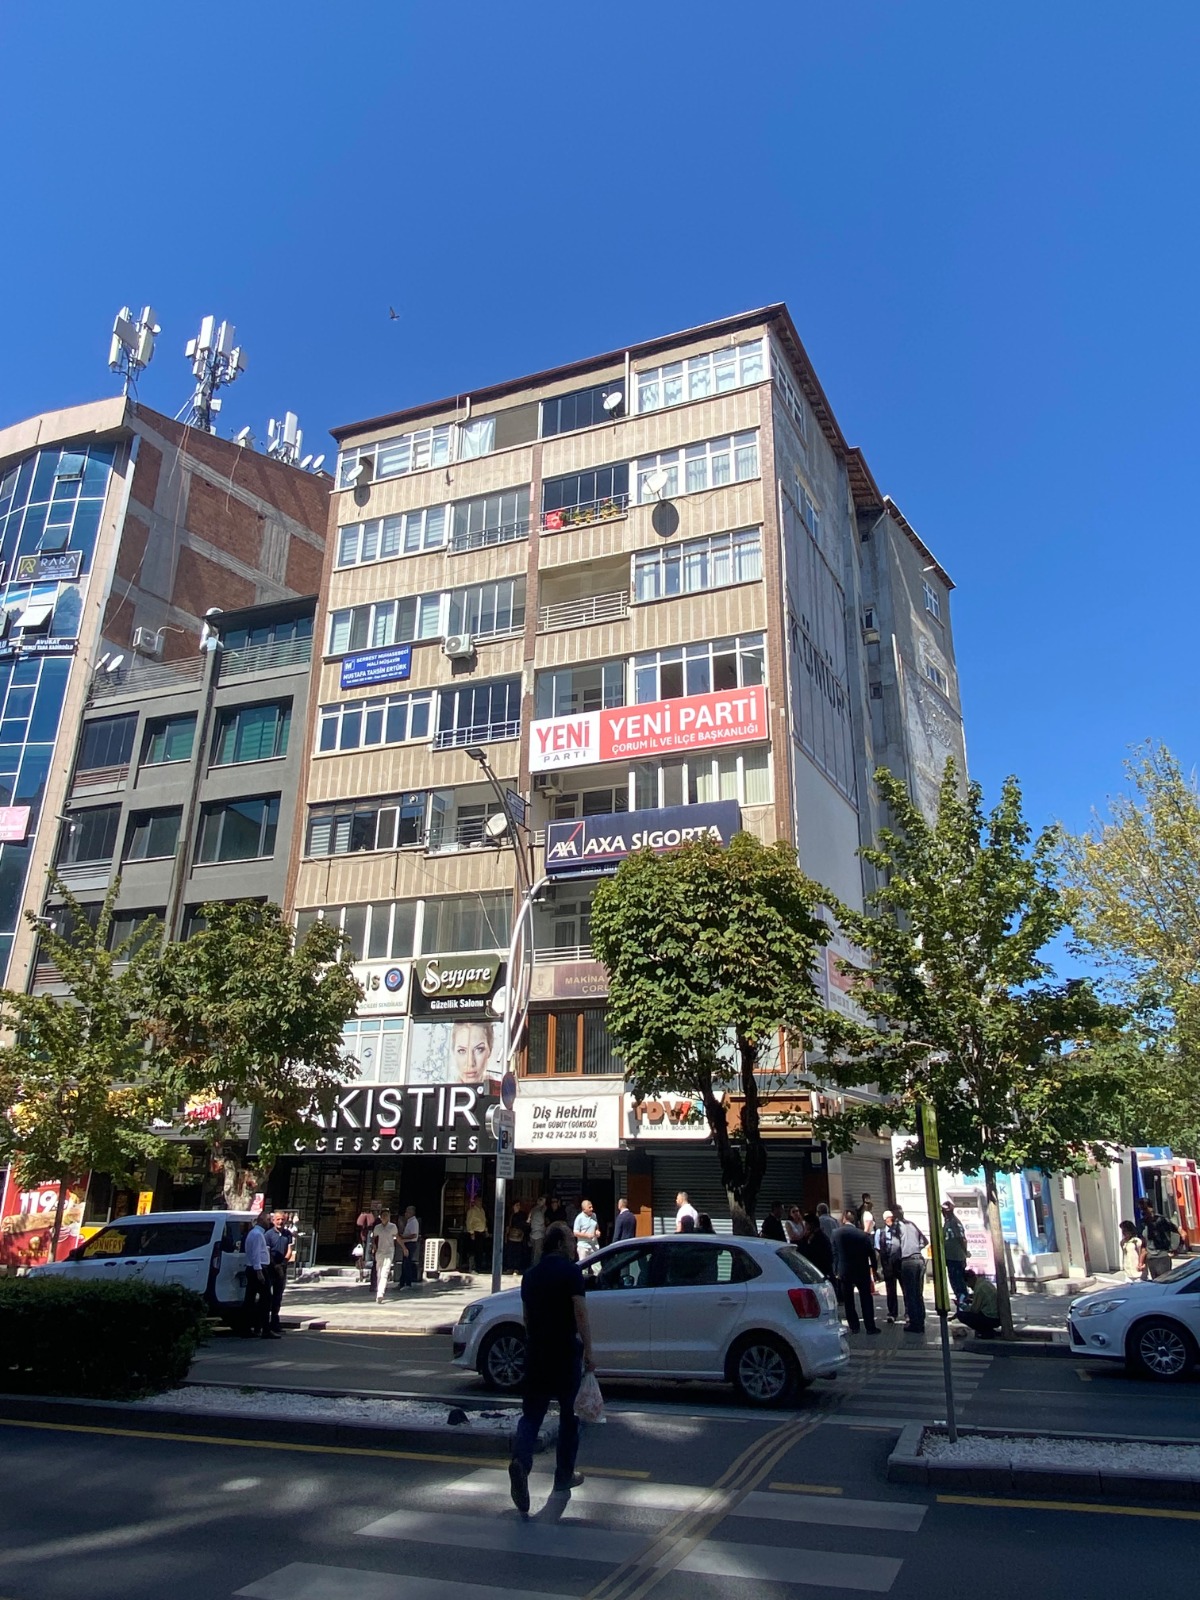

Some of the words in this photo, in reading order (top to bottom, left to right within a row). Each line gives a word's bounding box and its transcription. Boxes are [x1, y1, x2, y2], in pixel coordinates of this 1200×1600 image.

[41, 556, 76, 567] RARA
[356, 655, 377, 663] SERBEST
[378, 649, 408, 659] MUHASEBECİ
[343, 671, 366, 680] MUSTAFA
[367, 667, 385, 676] TAHSİN
[386, 663, 407, 673] ERTÜRK
[608, 704, 671, 741] YENİ
[679, 691, 757, 731] PARTİ
[536, 720, 590, 754] YENİ
[612, 740, 648, 755] ÇORUM
[649, 737, 658, 748] İL
[660, 736, 672, 746] VE
[674, 734, 696, 745] İLÇE
[699, 723, 758, 742] BAŞKANLIĞI
[543, 751, 587, 763] PARTİ
[583, 835, 627, 855] AXA
[631, 825, 723, 849] SİGORTA
[421, 959, 491, 994] Seyyare
[565, 975, 605, 985] MAKİNA
[430, 999, 458, 1010] Güzellik
[459, 998, 484, 1009] Salonu
[533, 1105, 552, 1121] Diş
[555, 1105, 598, 1118] Hekimi
[545, 1131, 554, 1139] 42
[579, 1131, 587, 1139] 15
